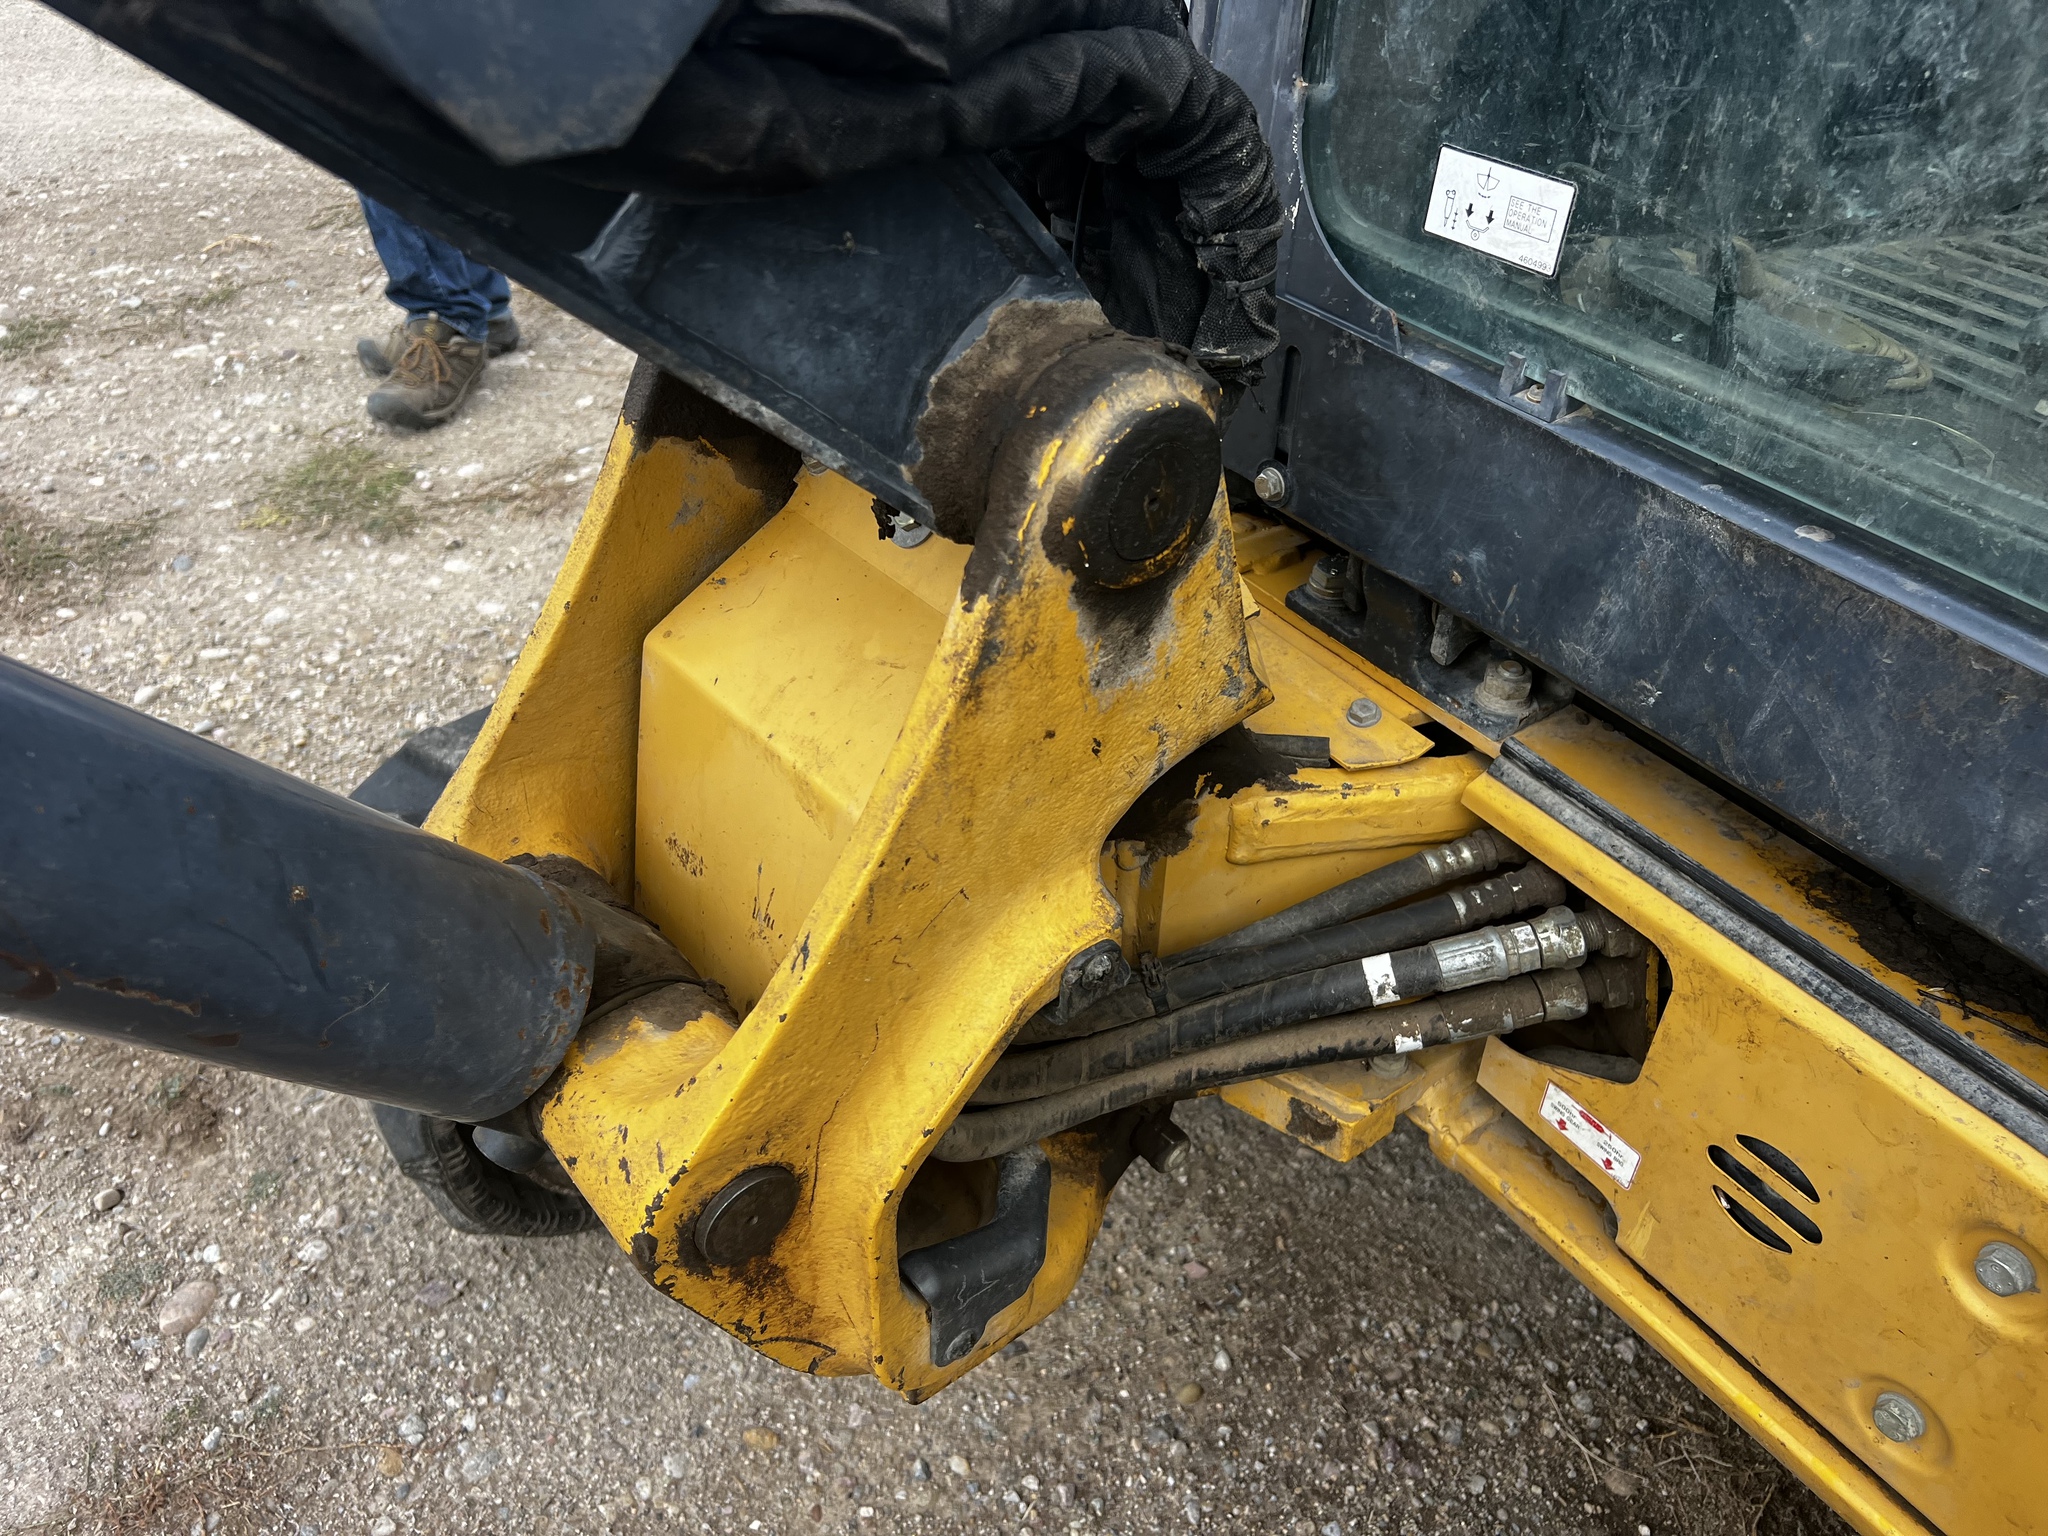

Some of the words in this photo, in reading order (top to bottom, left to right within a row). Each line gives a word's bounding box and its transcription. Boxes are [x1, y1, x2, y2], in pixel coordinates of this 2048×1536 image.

[1510, 198, 1525, 211] SEE
[1527, 203, 1542, 216] THE
[1508, 208, 1548, 229] OPERATION
[1506, 219, 1532, 235] MANUAL
[1550, 1102, 1565, 1117] SWING
[1596, 1141, 1612, 1157] SWING
